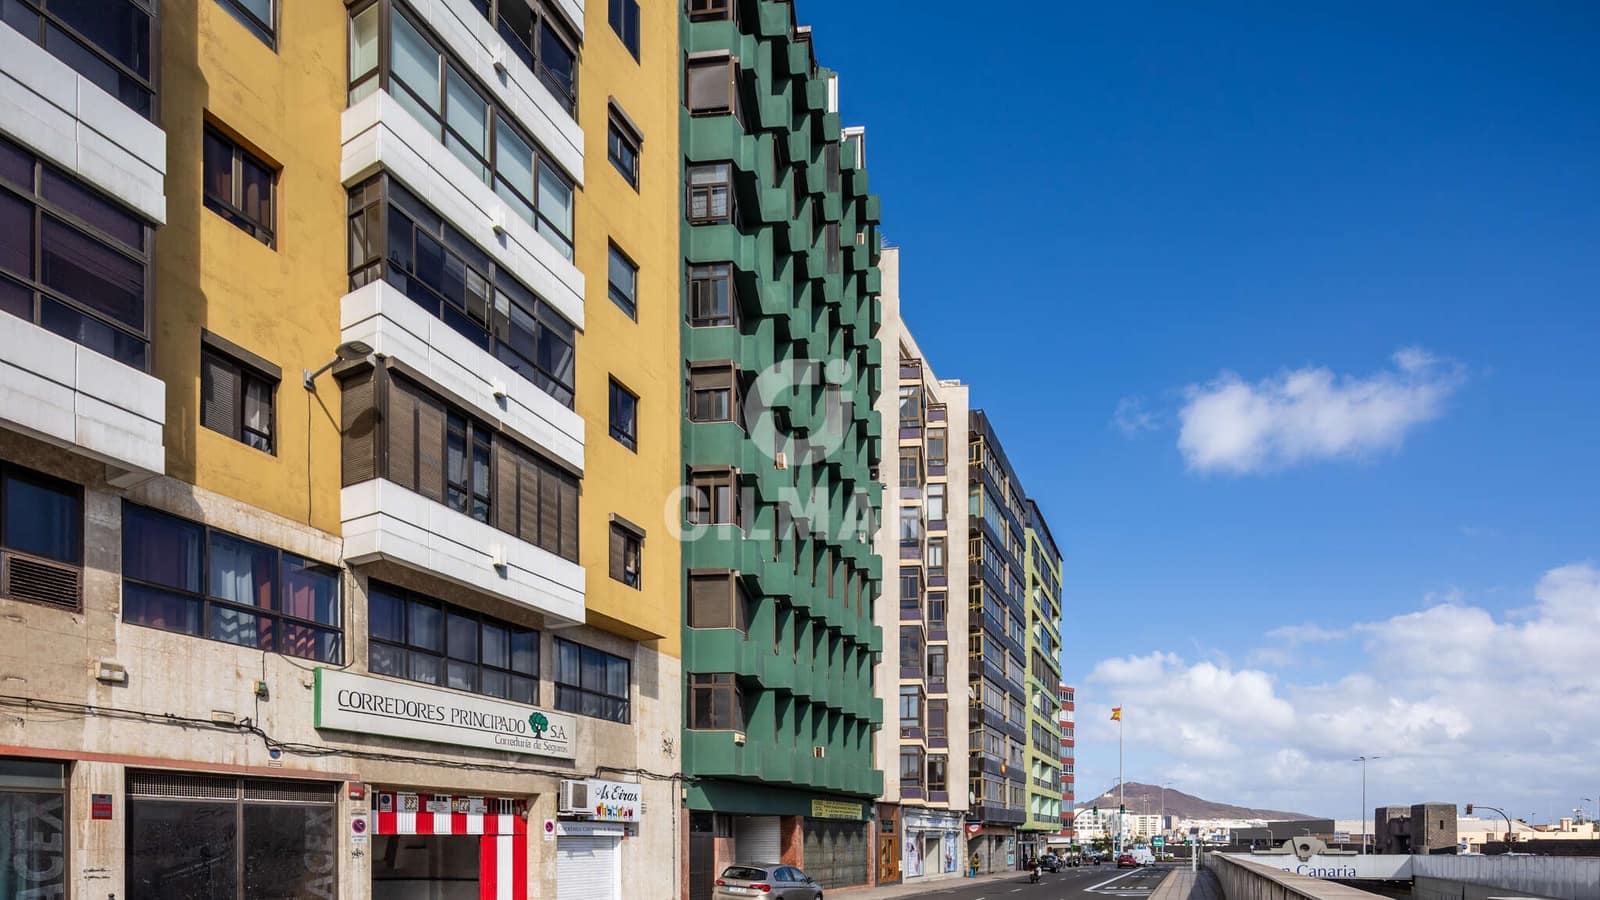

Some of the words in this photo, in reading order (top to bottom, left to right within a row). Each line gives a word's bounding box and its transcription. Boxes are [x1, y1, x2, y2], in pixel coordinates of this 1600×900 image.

[337, 689, 445, 721] CORREDORES
[450, 708, 526, 734] PRINCIPADO
[595, 784, 609, 800] As
[611, 785, 638, 801] Eiras
[1296, 864, 1357, 878] Canaria
